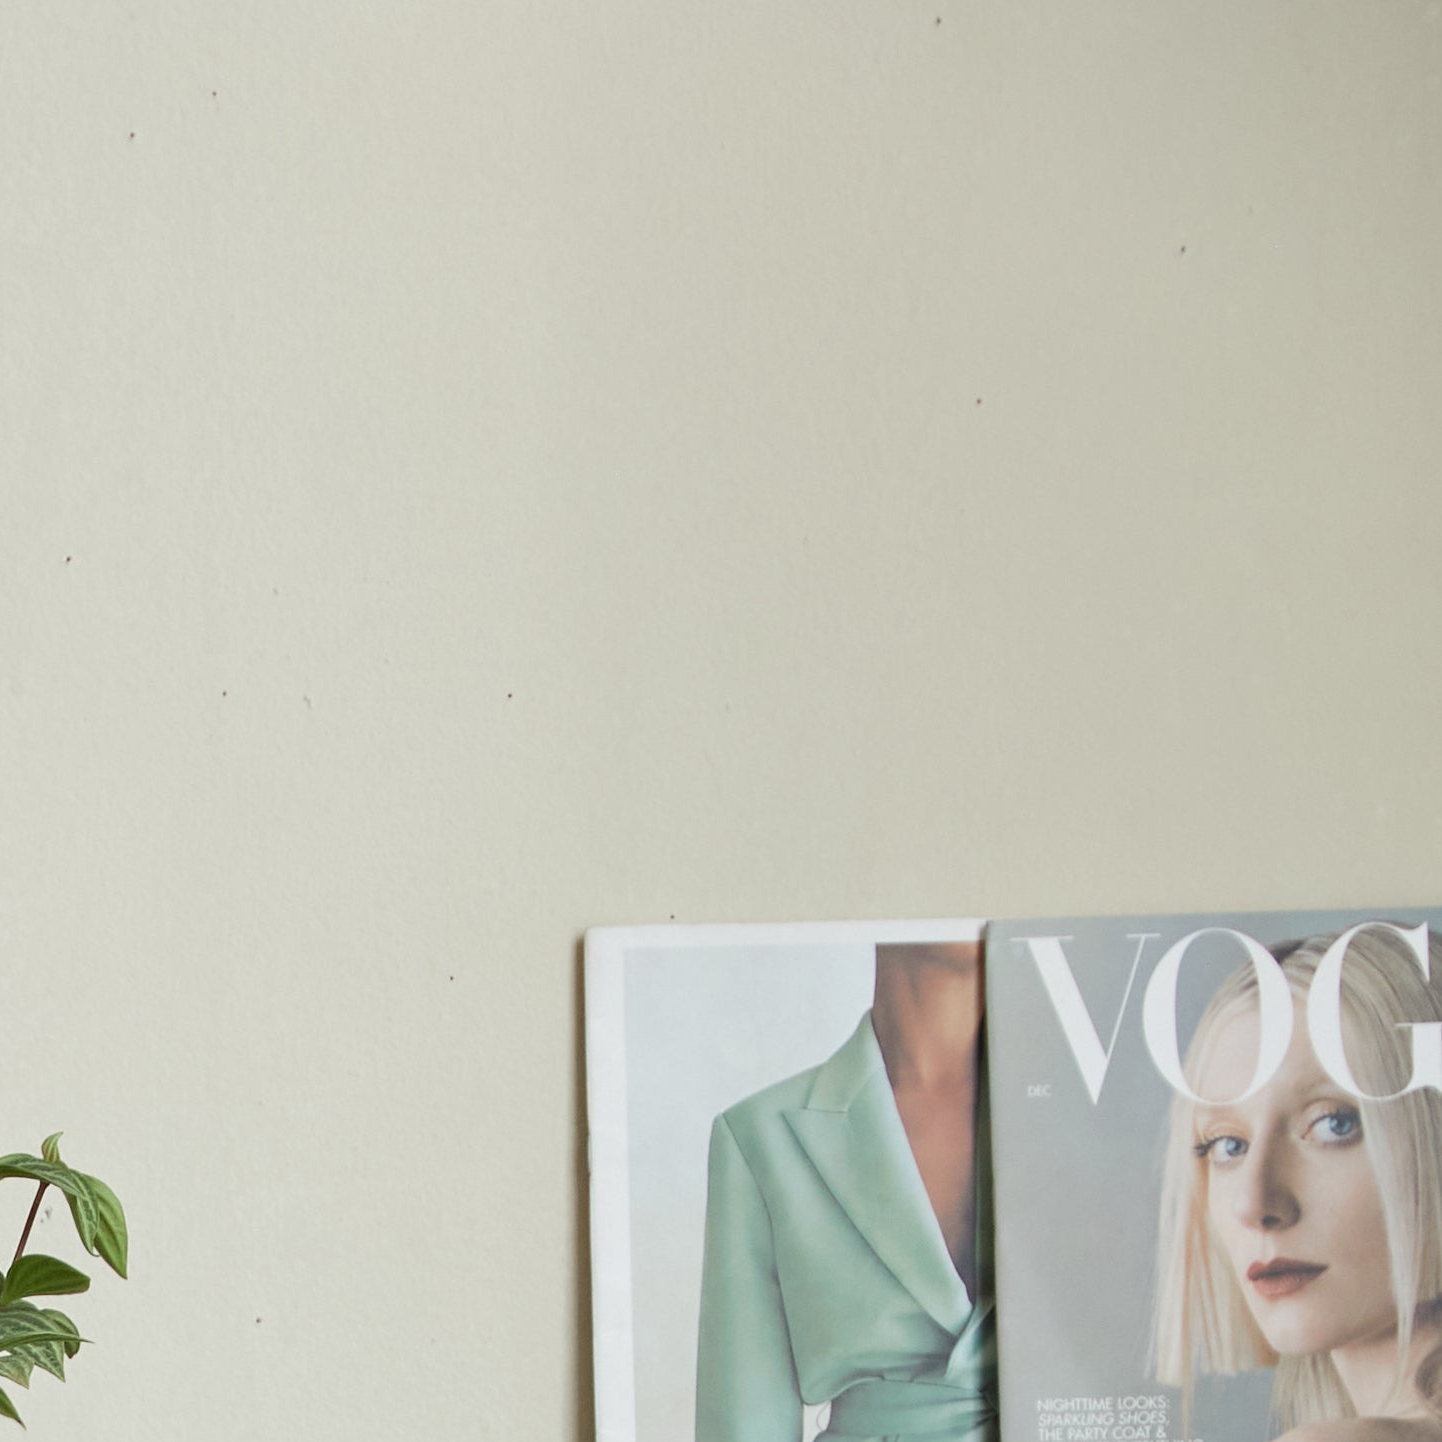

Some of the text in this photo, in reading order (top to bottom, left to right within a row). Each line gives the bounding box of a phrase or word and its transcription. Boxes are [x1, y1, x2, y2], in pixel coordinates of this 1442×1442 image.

[1027, 1084, 1052, 1097] DEC
[1037, 1397, 1113, 1411] NIGHTTIME
[1039, 1411, 1169, 1426] SPARKLING SHOES,
[1039, 1426, 1167, 1441] THE PARTY COAT &
